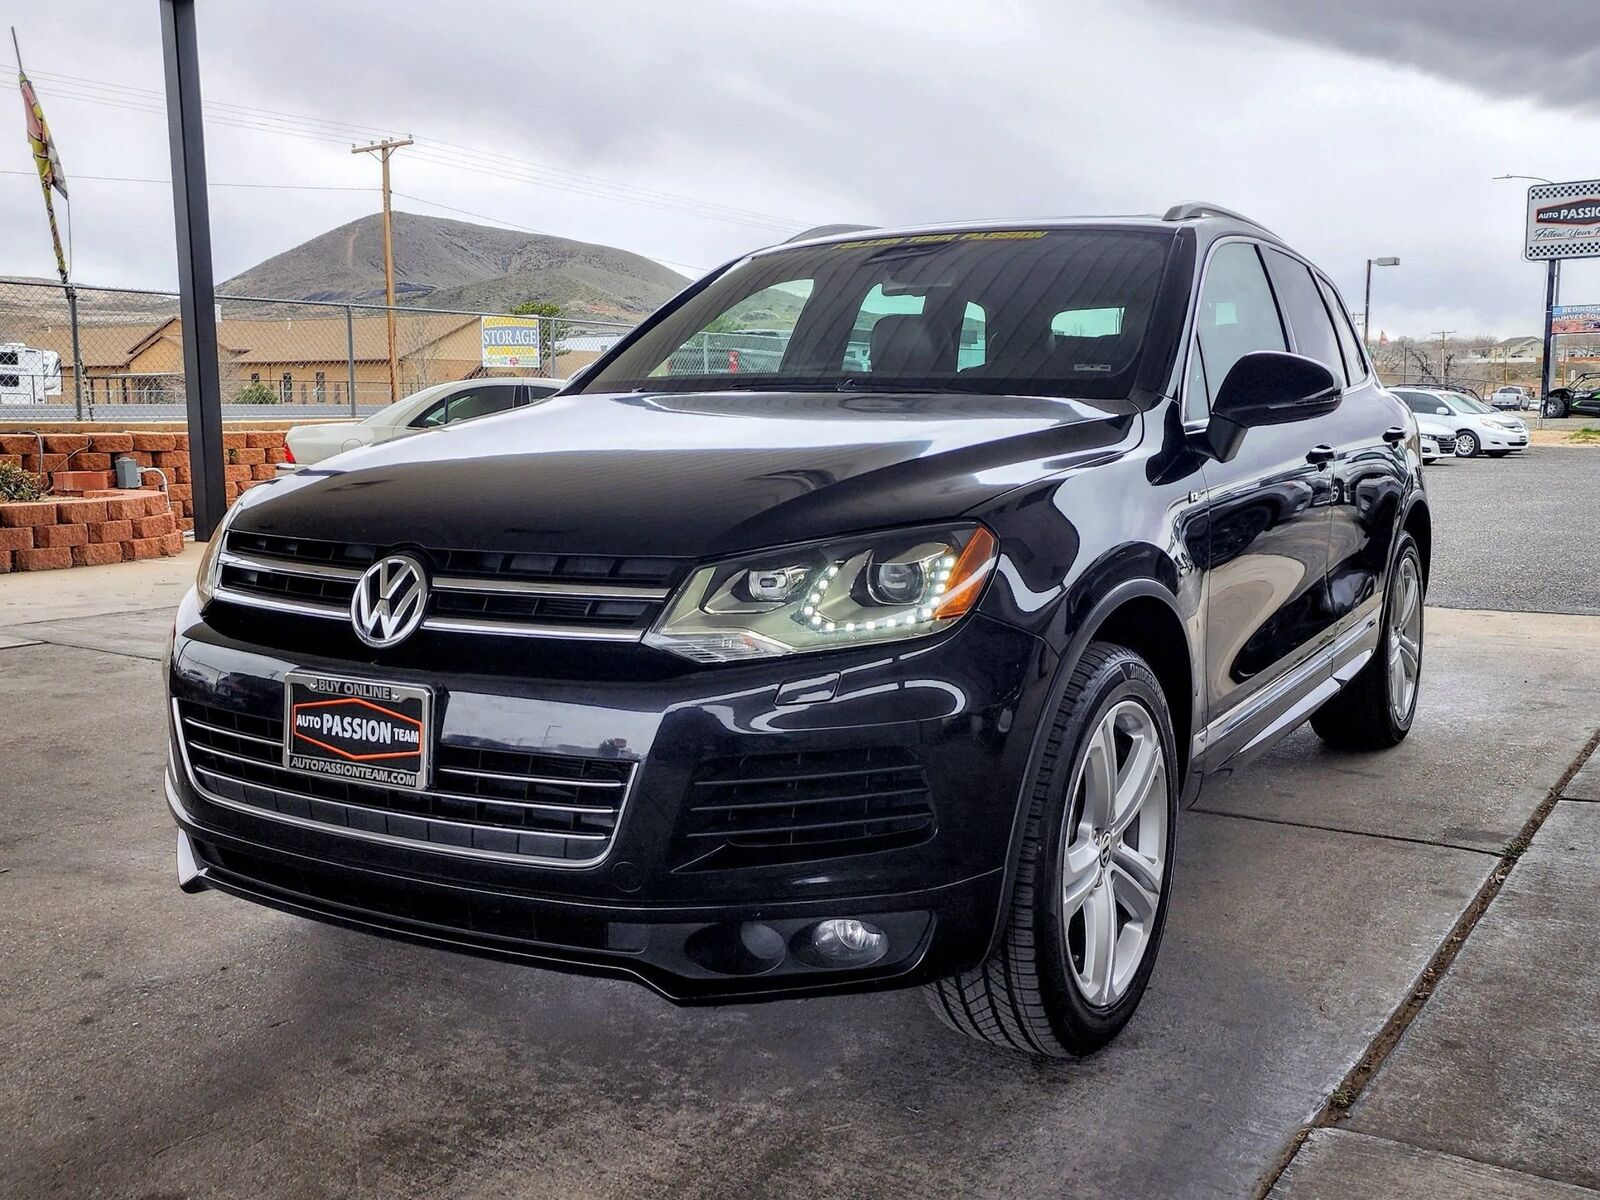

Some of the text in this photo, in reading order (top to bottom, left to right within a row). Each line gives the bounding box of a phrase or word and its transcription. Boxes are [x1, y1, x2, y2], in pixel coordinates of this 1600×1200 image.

[960, 231, 1050, 241] PASSION
[1535, 228, 1565, 240] Follow
[1567, 228, 1591, 239] Your
[484, 329, 537, 345] STORAGE
[318, 679, 391, 699] BUY ONLINE
[296, 713, 419, 744] AUTO PASSION TEAM
[291, 756, 416, 786] AUTOPASSIONTEAM.COM
